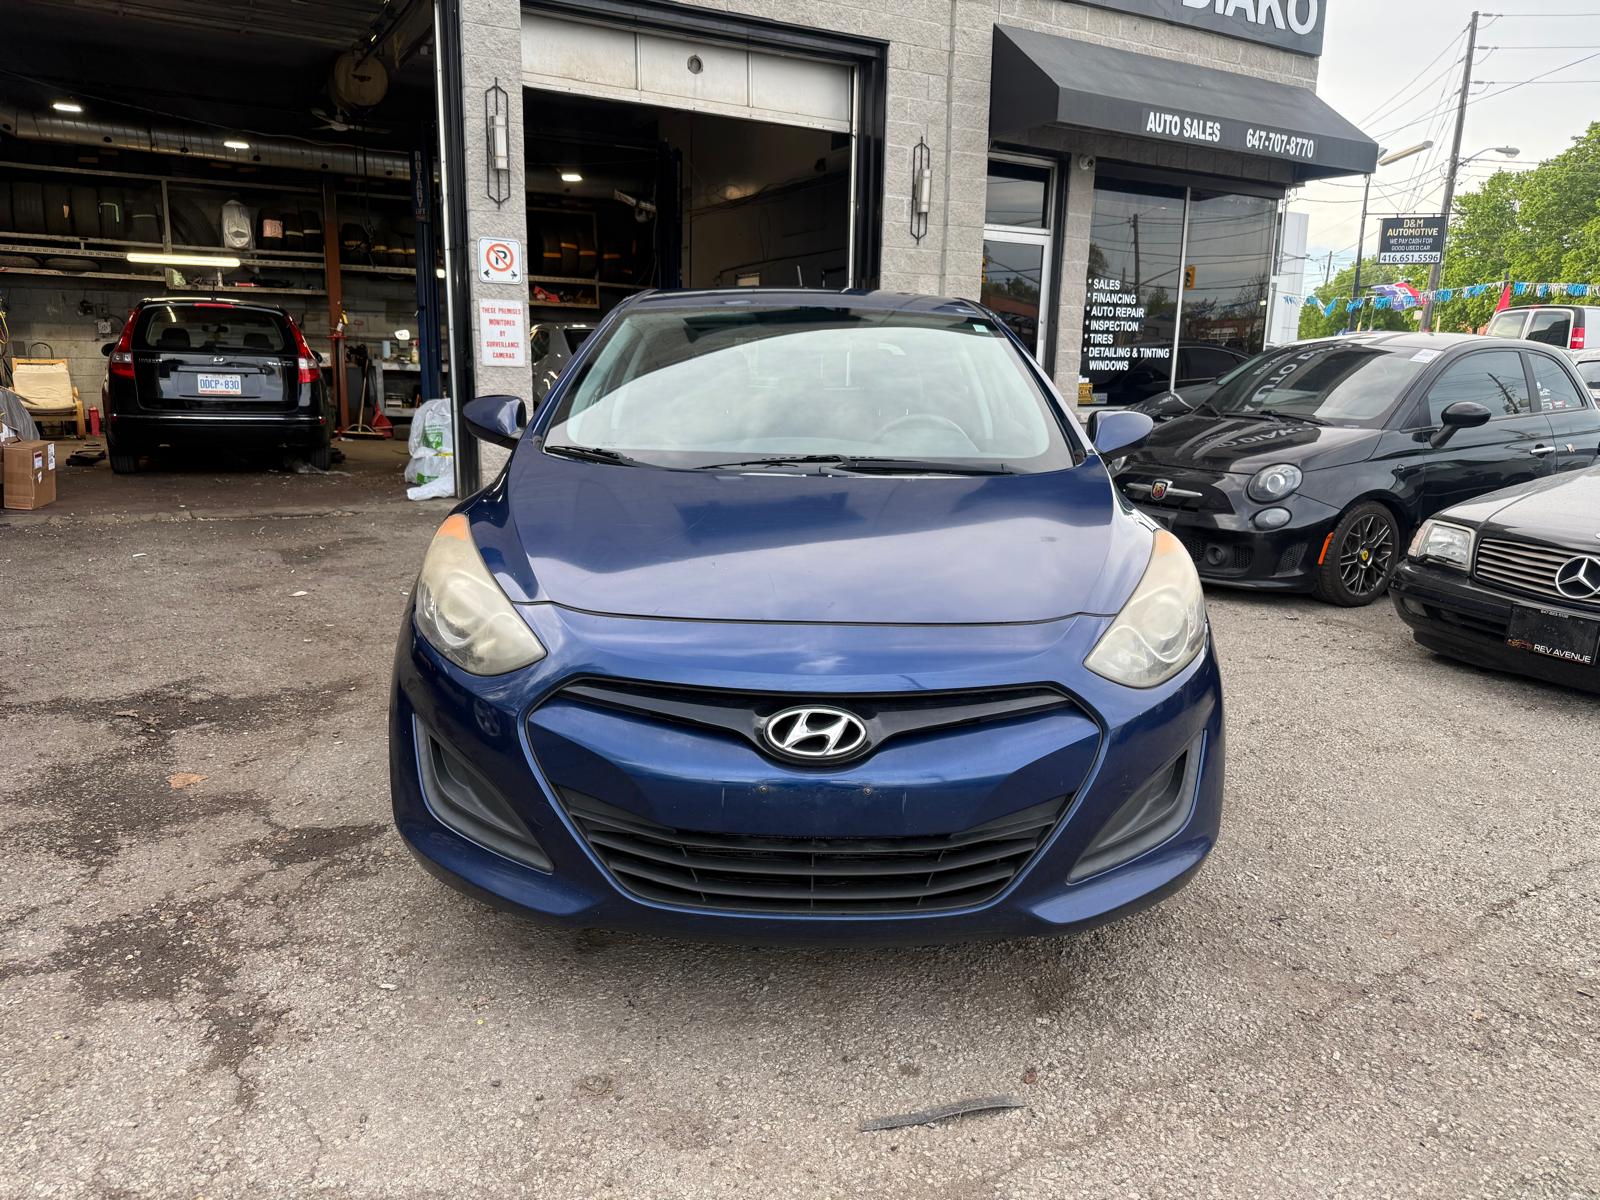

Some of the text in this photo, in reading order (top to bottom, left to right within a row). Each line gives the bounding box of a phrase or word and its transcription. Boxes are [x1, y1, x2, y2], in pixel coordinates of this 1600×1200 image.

[1146, 112, 1221, 142] AUTO SALES
[1246, 128, 1314, 158] 647-707-8770
[1403, 219, 1424, 228] D&M
[1387, 228, 1439, 236] AUTOMOTIVE
[1381, 254, 1439, 262] 416.651.5596
[1093, 279, 1121, 290] SALES
[1092, 293, 1136, 305] FINANCING
[498, 307, 521, 315] PREMISES
[1091, 306, 1145, 318] AUTO REPAIR
[488, 318, 516, 326] MONITORED
[1090, 320, 1139, 331] INSPECTION
[1089, 333, 1114, 344] TIRES
[1088, 347, 1170, 359] DETAILING & TINTING
[1088, 360, 1129, 371] WINDOWS
[1533, 643, 1592, 665] REV AVENUE
